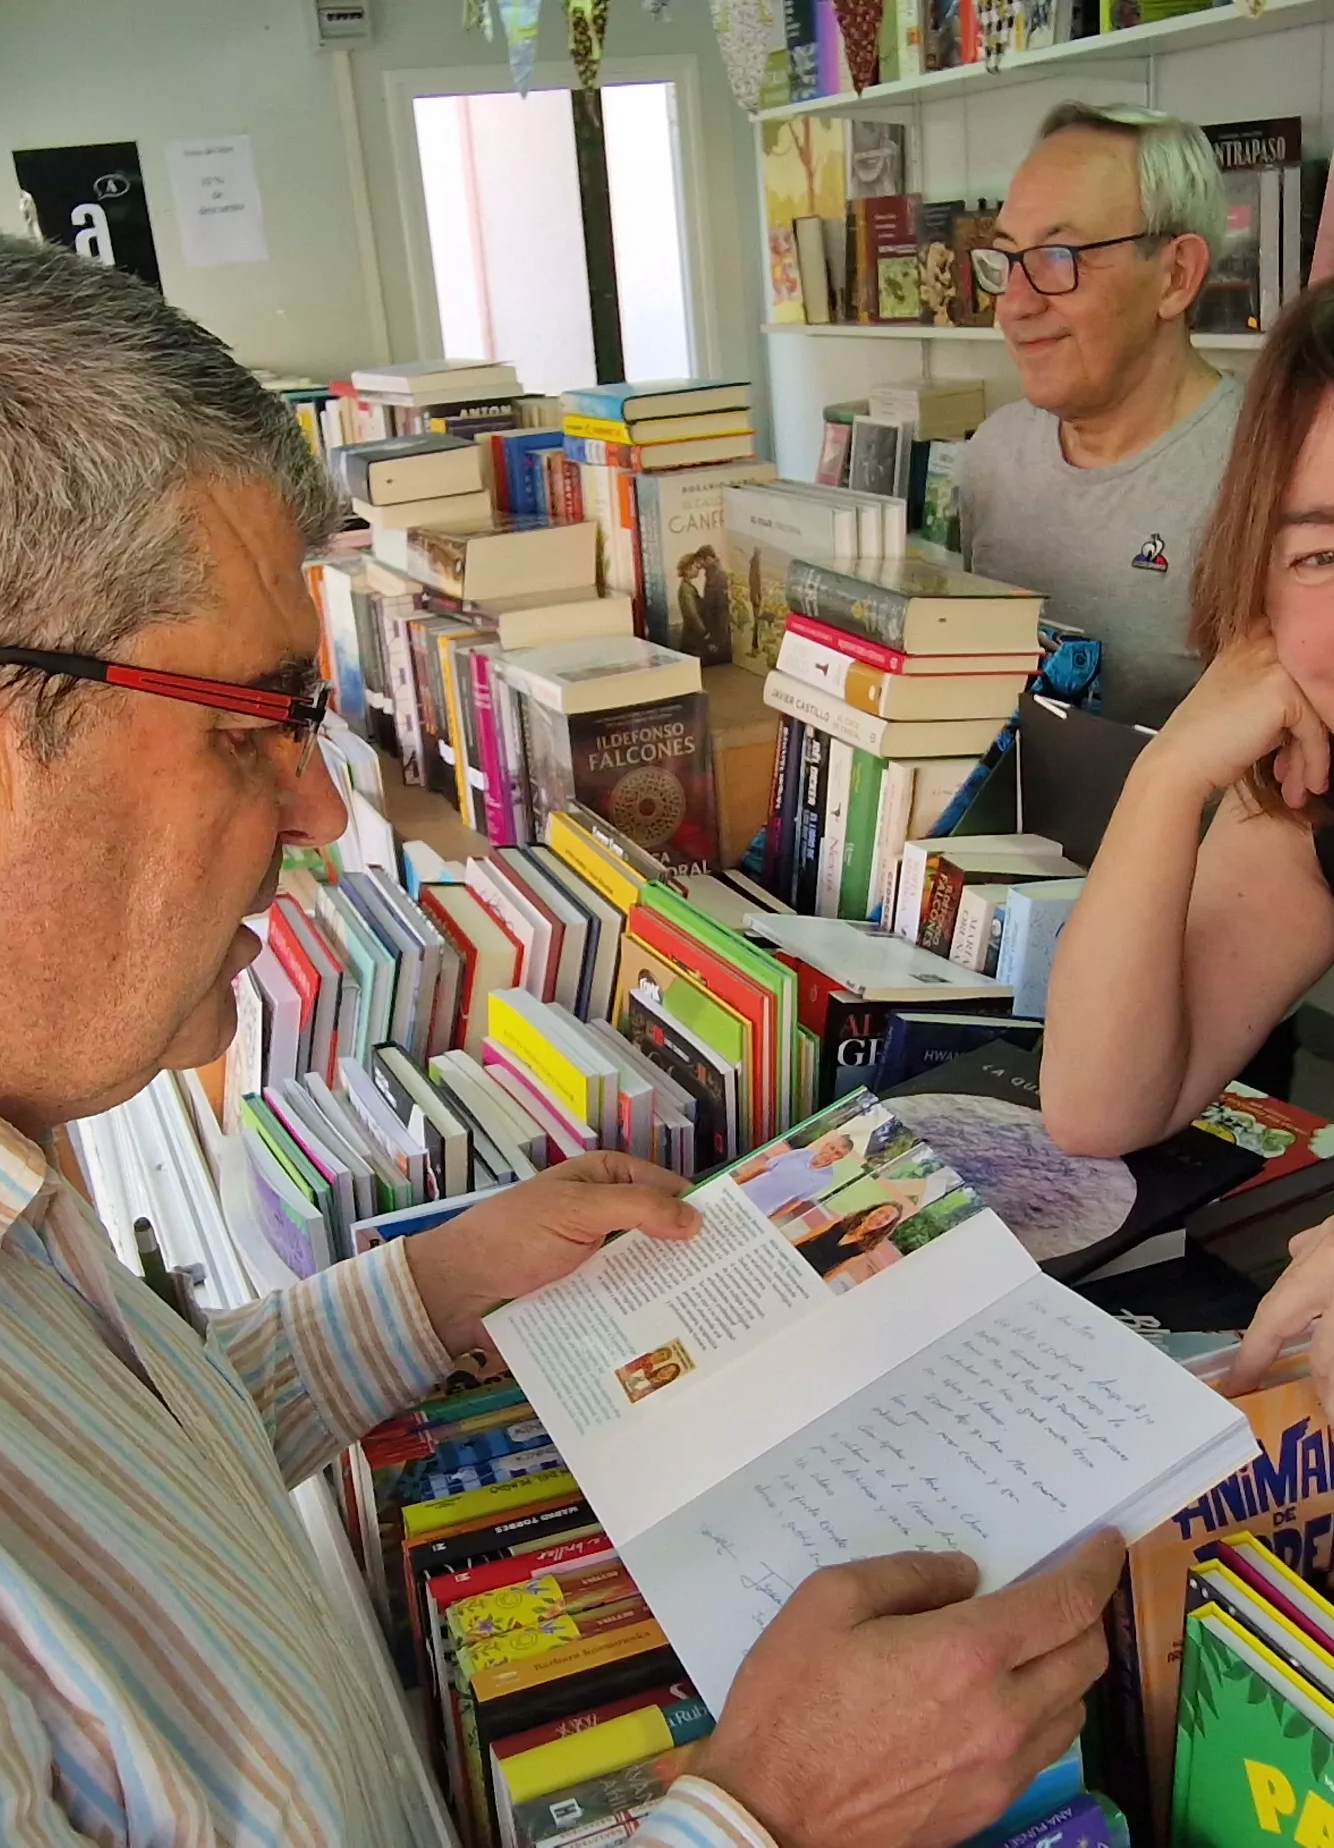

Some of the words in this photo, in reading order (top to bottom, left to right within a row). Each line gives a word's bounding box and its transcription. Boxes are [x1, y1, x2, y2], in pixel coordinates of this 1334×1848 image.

[1212, 136, 1286, 169] NTRAPASO
[70, 202, 116, 266] a
[597, 721, 685, 751] ILDEFONSO
[589, 736, 696, 772] FALCONES
[923, 873, 949, 947] FALCONES
[1273, 1505, 1298, 1529] DE
